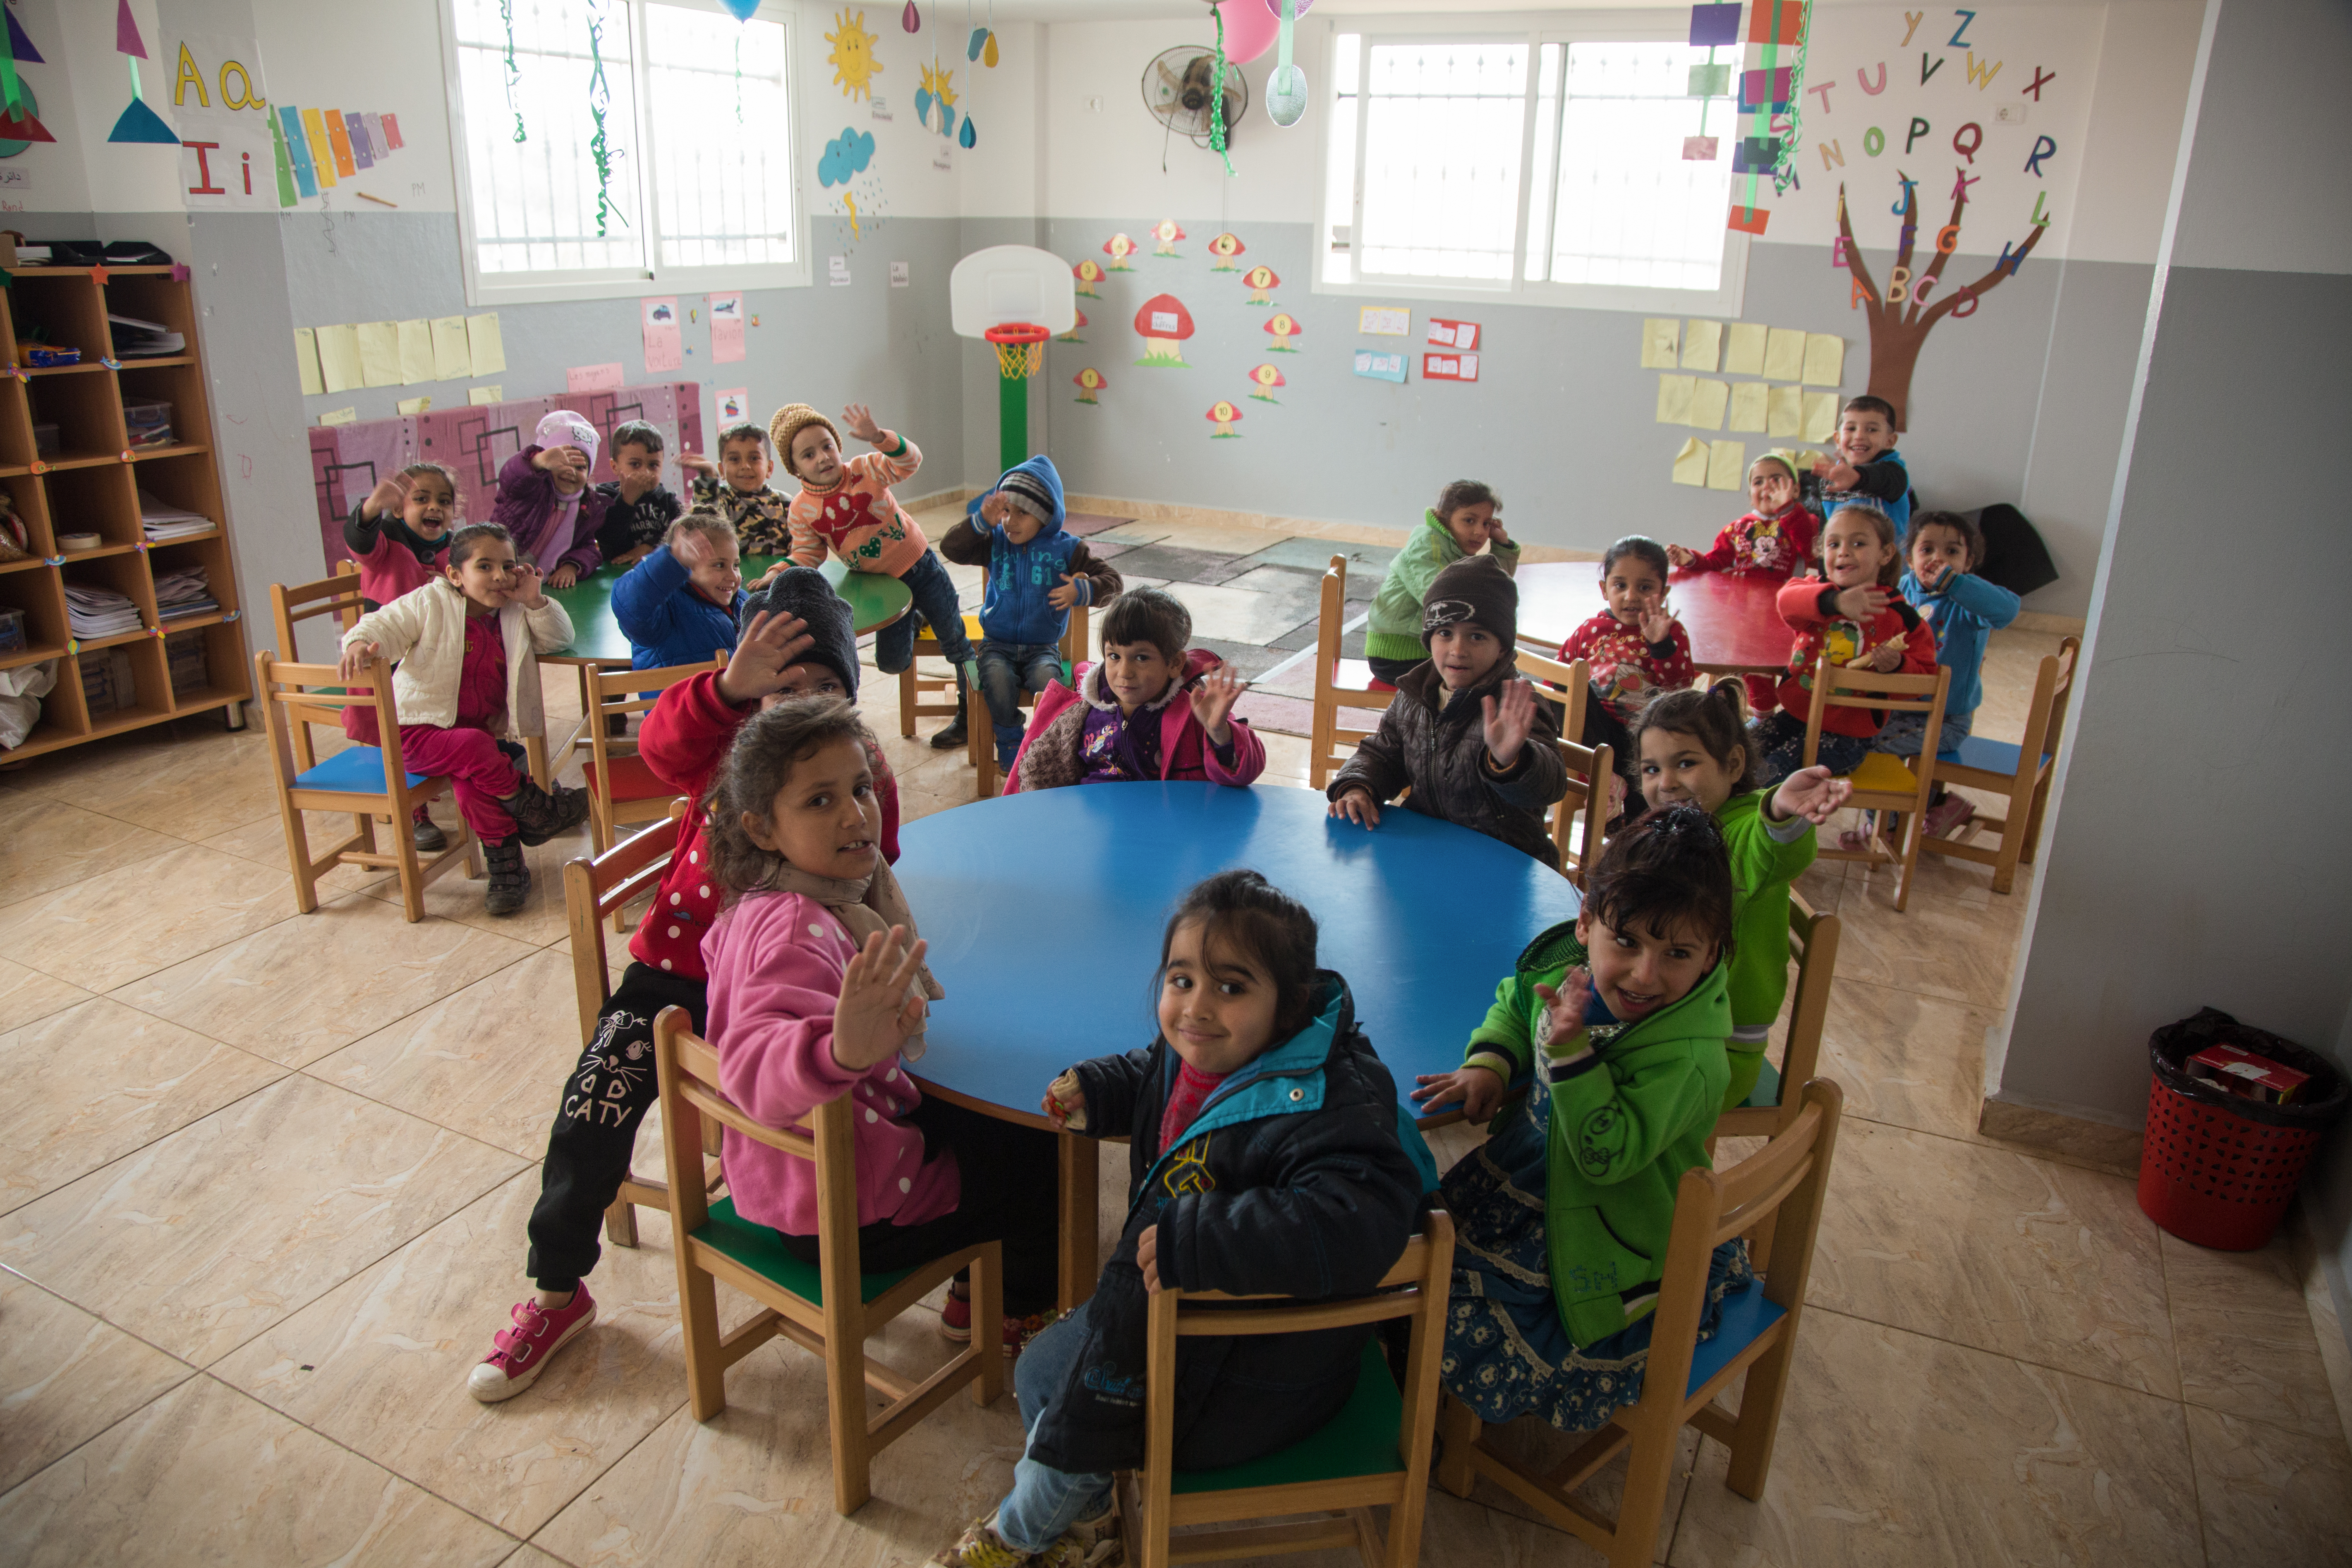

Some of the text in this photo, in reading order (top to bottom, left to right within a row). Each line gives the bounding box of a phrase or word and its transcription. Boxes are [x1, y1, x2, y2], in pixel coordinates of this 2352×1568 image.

[1902, 10, 1976, 48] Y Z
[1808, 81, 1836, 114] T
[1858, 62, 1887, 96] U
[1921, 52, 1945, 86] V
[1967, 52, 2003, 91] W
[2022, 66, 2056, 102] X
[1819, 139, 1845, 171] N
[1863, 127, 1885, 157] O
[1906, 117, 1930, 154] P
[1953, 122, 1983, 165] Q
[2024, 136, 2057, 178] R
[1892, 182, 1918, 215] J
[1951, 170, 1981, 203] K
[2031, 192, 2050, 227] L
[280, 211, 292, 220] AM
[344, 211, 356, 223] PM
[1833, 225, 2027, 276] E F G H
[1085, 265, 1090, 274] 3
[1260, 271, 1266, 284] 7
[1852, 267, 1978, 318] A B C D
[1279, 321, 1285, 329] 8
[1088, 374, 1092, 383] 1
[1265, 370, 1271, 378] 9
[1219, 407, 1228, 416] 10
[1031, 565, 1053, 586] 61
[565, 1095, 632, 1127] CATY
